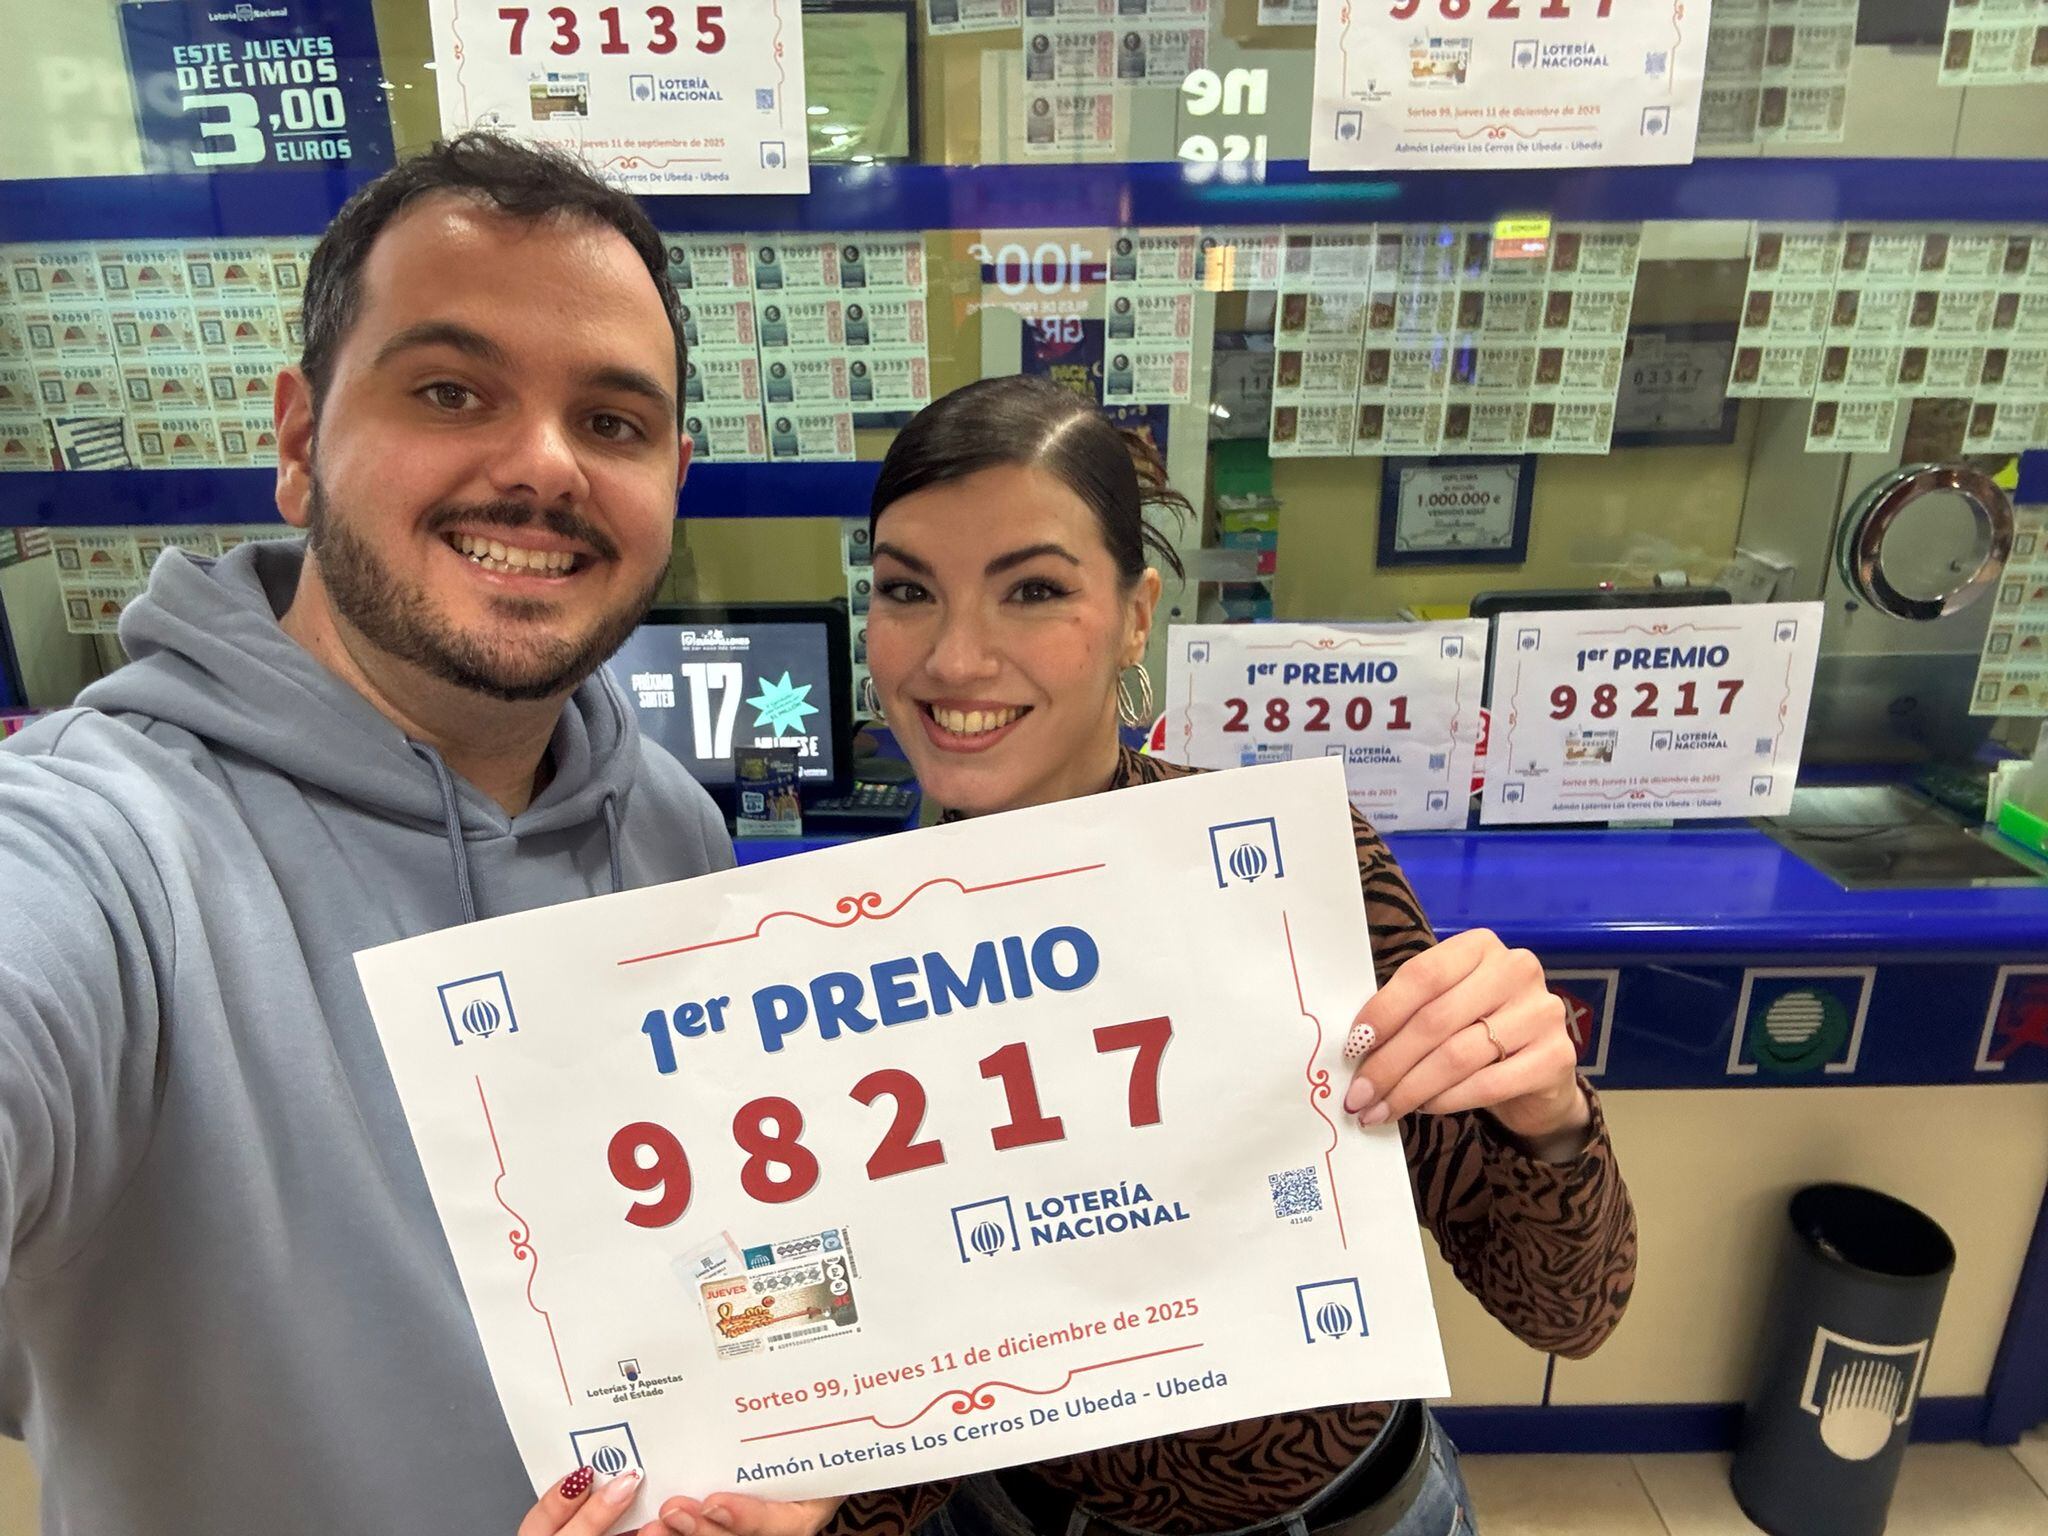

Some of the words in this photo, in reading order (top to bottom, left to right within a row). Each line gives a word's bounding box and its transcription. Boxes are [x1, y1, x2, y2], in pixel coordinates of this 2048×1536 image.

[498, 6, 726, 56] 73135
[173, 43, 231, 64] ESTE
[241, 36, 334, 61] JUEVES
[1543, 43, 1596, 56] LOTERÍA
[1542, 54, 1609, 68] NACIONAL
[658, 77, 710, 90] LOTERÍA
[659, 88, 723, 101] NACIONAL
[1486, 107, 1496, 116] 11
[1499, 106, 1510, 116] de
[1513, 105, 1560, 116] diciembre
[1562, 105, 1573, 115] de
[275, 139, 352, 162] EUROS
[612, 138, 621, 148] 11
[624, 138, 635, 148] de
[638, 138, 688, 150] septiembre
[690, 138, 701, 148] de
[704, 138, 726, 148] 2025
[1468, 142, 1482, 152] Los
[1485, 141, 1514, 152] Cerros
[1517, 141, 1529, 151] De
[650, 173, 662, 182] De
[664, 172, 692, 182] Ubeda
[701, 172, 729, 182] Ubeda
[1418, 492, 1490, 508] 1.000.000
[1577, 649, 1609, 672] 1er
[1613, 645, 1730, 671] PREMIO
[1247, 662, 1278, 686] 1er
[1283, 661, 1398, 686] PREMIO
[1549, 679, 1745, 721] 98217
[681, 663, 743, 760] 17
[1222, 695, 1413, 734] 28201
[1676, 731, 1720, 743] LOTERÍA
[1349, 744, 1392, 756] LOTERÍA
[1675, 740, 1728, 751] NACIONAL
[1349, 754, 1402, 765] NACIONAL
[1640, 776, 1649, 785] de
[1651, 775, 1688, 784] diciembre
[1690, 775, 1700, 783] de
[641, 994, 732, 1075] 1er
[752, 925, 1101, 1054] PREMIO
[607, 1016, 1175, 1230] 98217
[1025, 1181, 1154, 1222] LOTERÍA
[1030, 1202, 1190, 1248] NACIONAL
[1290, 1216, 1313, 1225] 41140
[706, 1285, 748, 1300] JUEVES
[735, 1389, 808, 1413] Sorteo
[813, 1378, 849, 1398] 99,
[853, 1363, 925, 1395] jueves
[930, 1353, 957, 1373] 11
[964, 1347, 991, 1367] de
[997, 1321, 1107, 1358] diciembre
[1113, 1311, 1140, 1331] de
[1145, 1298, 1199, 1325] 2025
[637, 1374, 684, 1389] Apuestas
[612, 1393, 628, 1404] del
[629, 1387, 664, 1400] Estado
[735, 1457, 814, 1483] Admón
[819, 1441, 906, 1468] Loterias
[911, 1431, 947, 1451] Los
[953, 1416, 1024, 1442] Cerros
[1029, 1408, 1060, 1427] De
[1065, 1390, 1137, 1418] Ubeda
[1156, 1370, 1228, 1398] Ubeda
